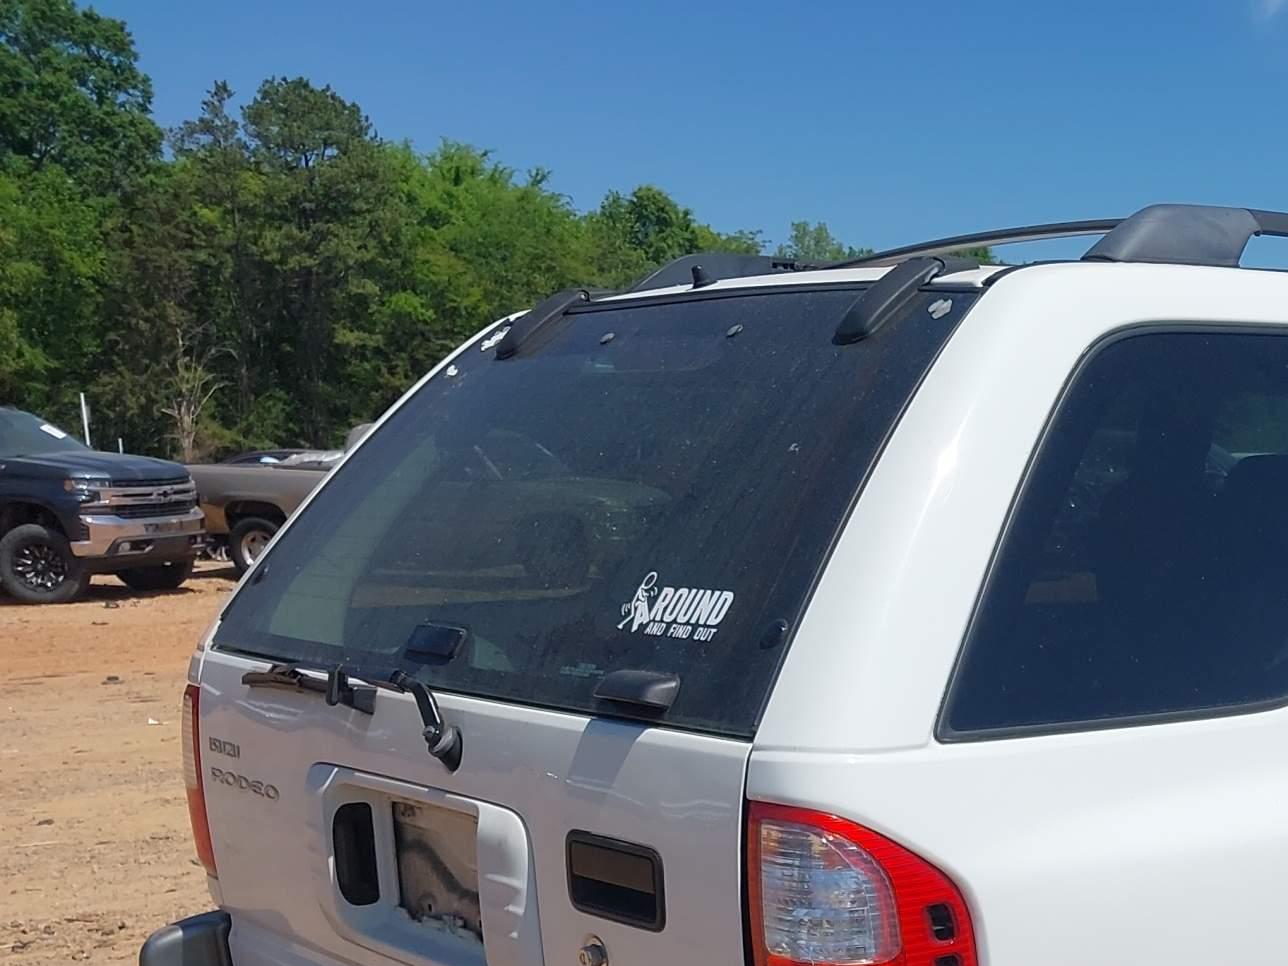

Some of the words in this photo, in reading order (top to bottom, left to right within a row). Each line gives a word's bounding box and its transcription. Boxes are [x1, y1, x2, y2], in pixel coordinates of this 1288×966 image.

[644, 622, 667, 637] AND
[667, 624, 693, 639] FIND
[693, 627, 718, 642] OUT
[210, 767, 281, 802] RODEO
